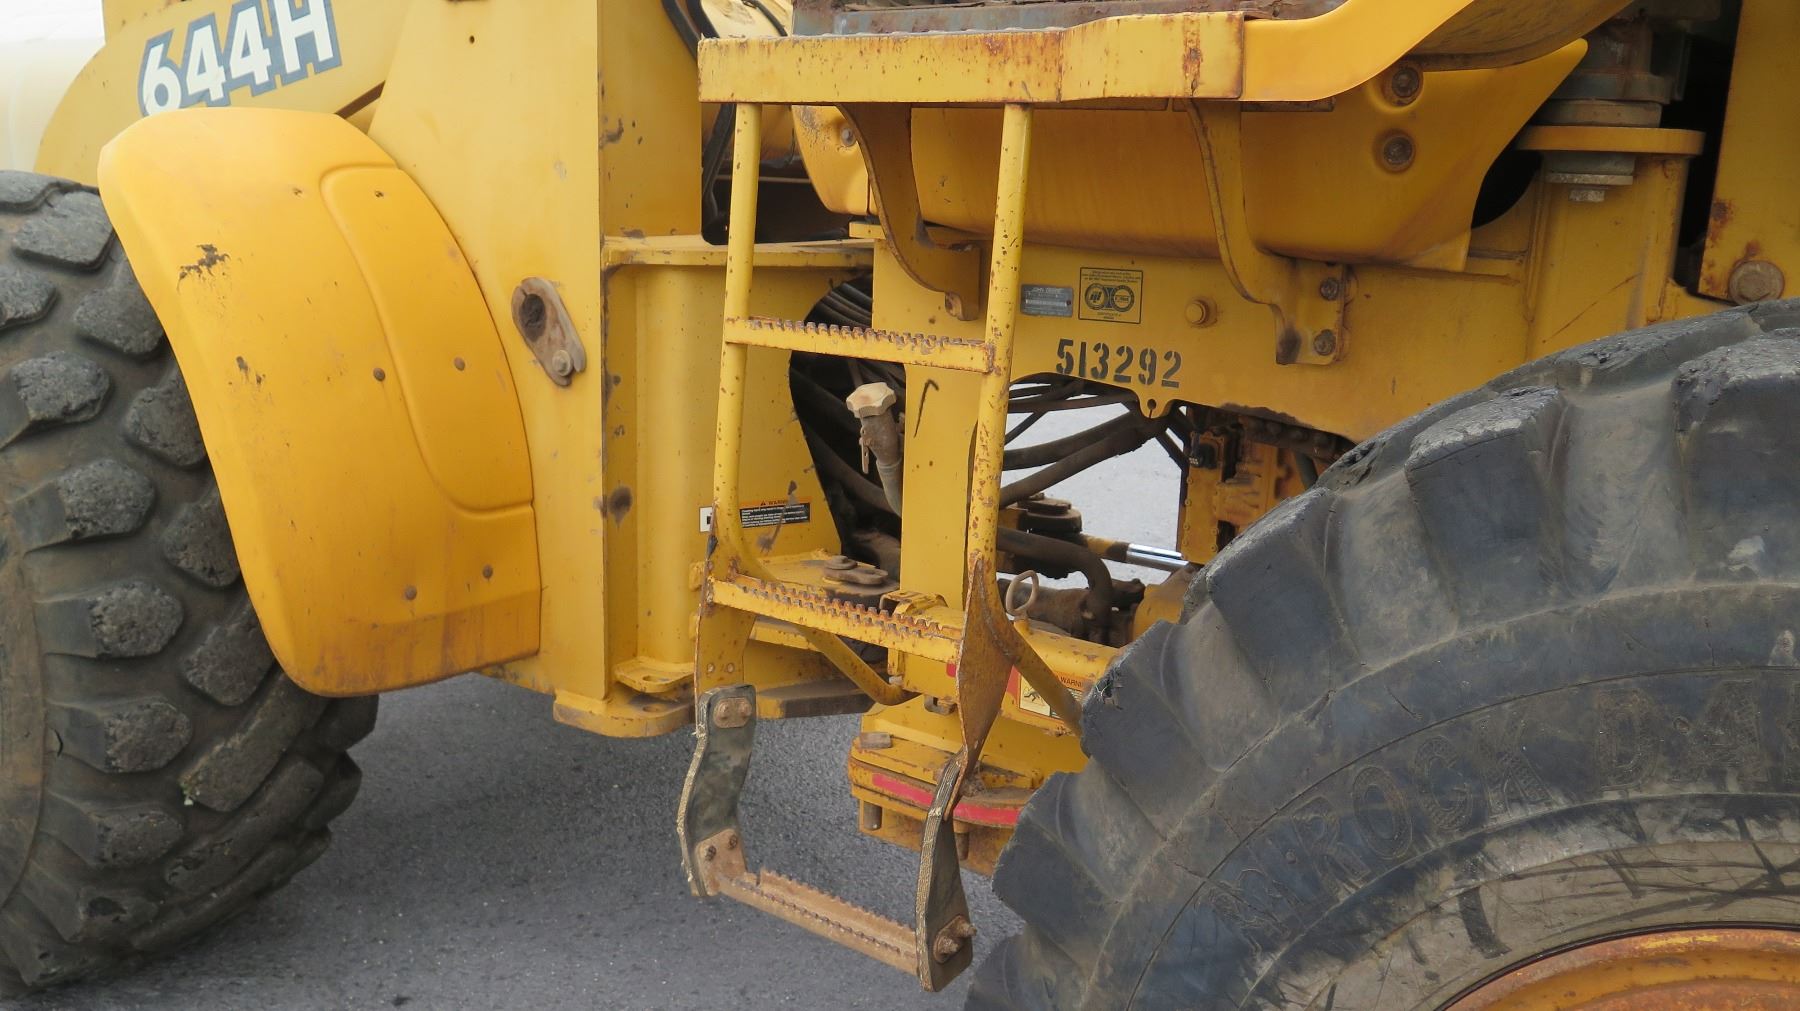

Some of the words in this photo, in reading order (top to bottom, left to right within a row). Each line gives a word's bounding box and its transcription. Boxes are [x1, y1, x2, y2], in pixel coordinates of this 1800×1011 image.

[138, 0, 342, 117] 644H
[1056, 338, 1182, 388] 513292
[1060, 676, 1082, 687] WARNI
